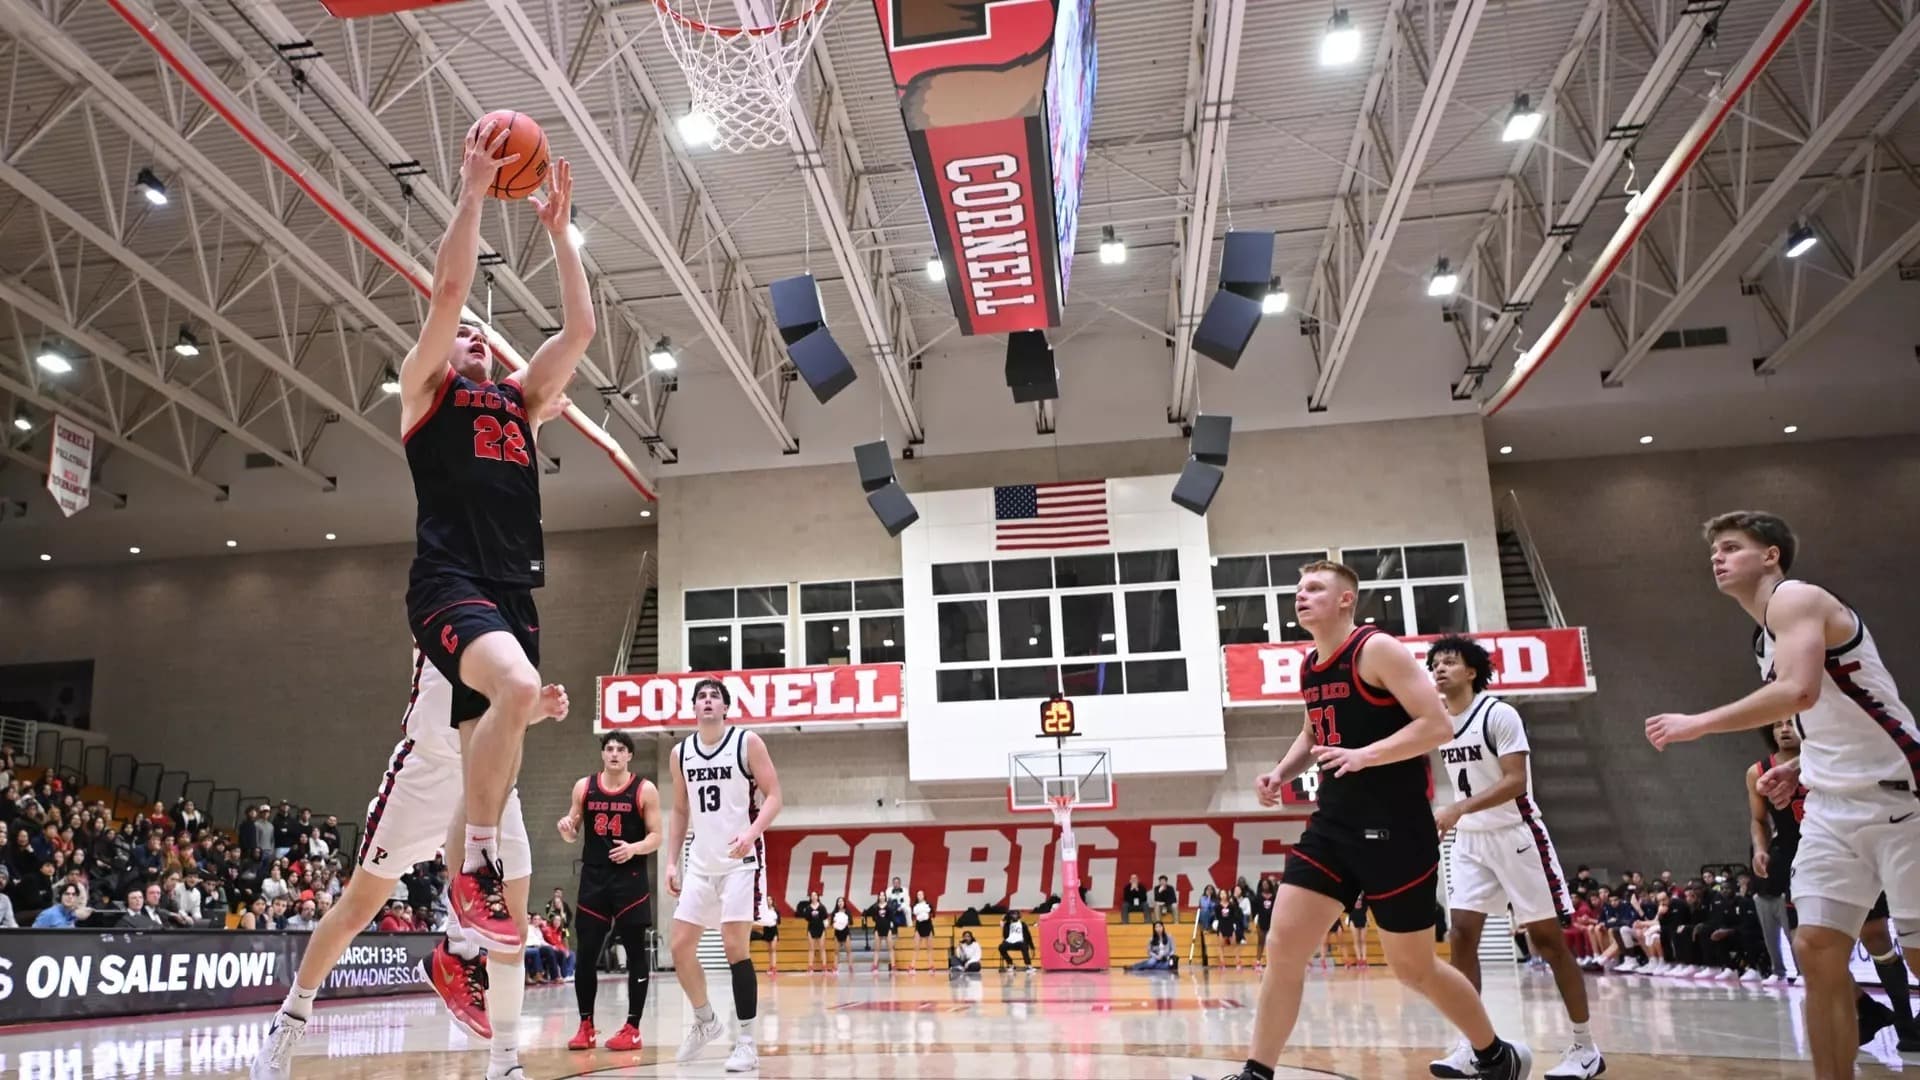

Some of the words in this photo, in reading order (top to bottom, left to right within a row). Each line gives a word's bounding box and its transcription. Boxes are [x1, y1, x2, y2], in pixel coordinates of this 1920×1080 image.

[945, 153, 1035, 316] CORNELL
[454, 388, 501, 409] BIG
[473, 414, 530, 468] 22
[1045, 710, 1071, 732] 22
[1309, 705, 1341, 747] 31
[1440, 744, 1482, 764] PENN
[687, 766, 733, 782] PENN
[1458, 768, 1473, 798] 4
[698, 785, 721, 813] 13
[372, 846, 388, 865] P
[785, 831, 915, 913] GO
[938, 826, 1119, 912] BIG
[380, 947, 407, 964] 13-15
[26, 955, 92, 999] ON
[97, 953, 190, 995] SALE
[193, 952, 276, 990] NOW!
